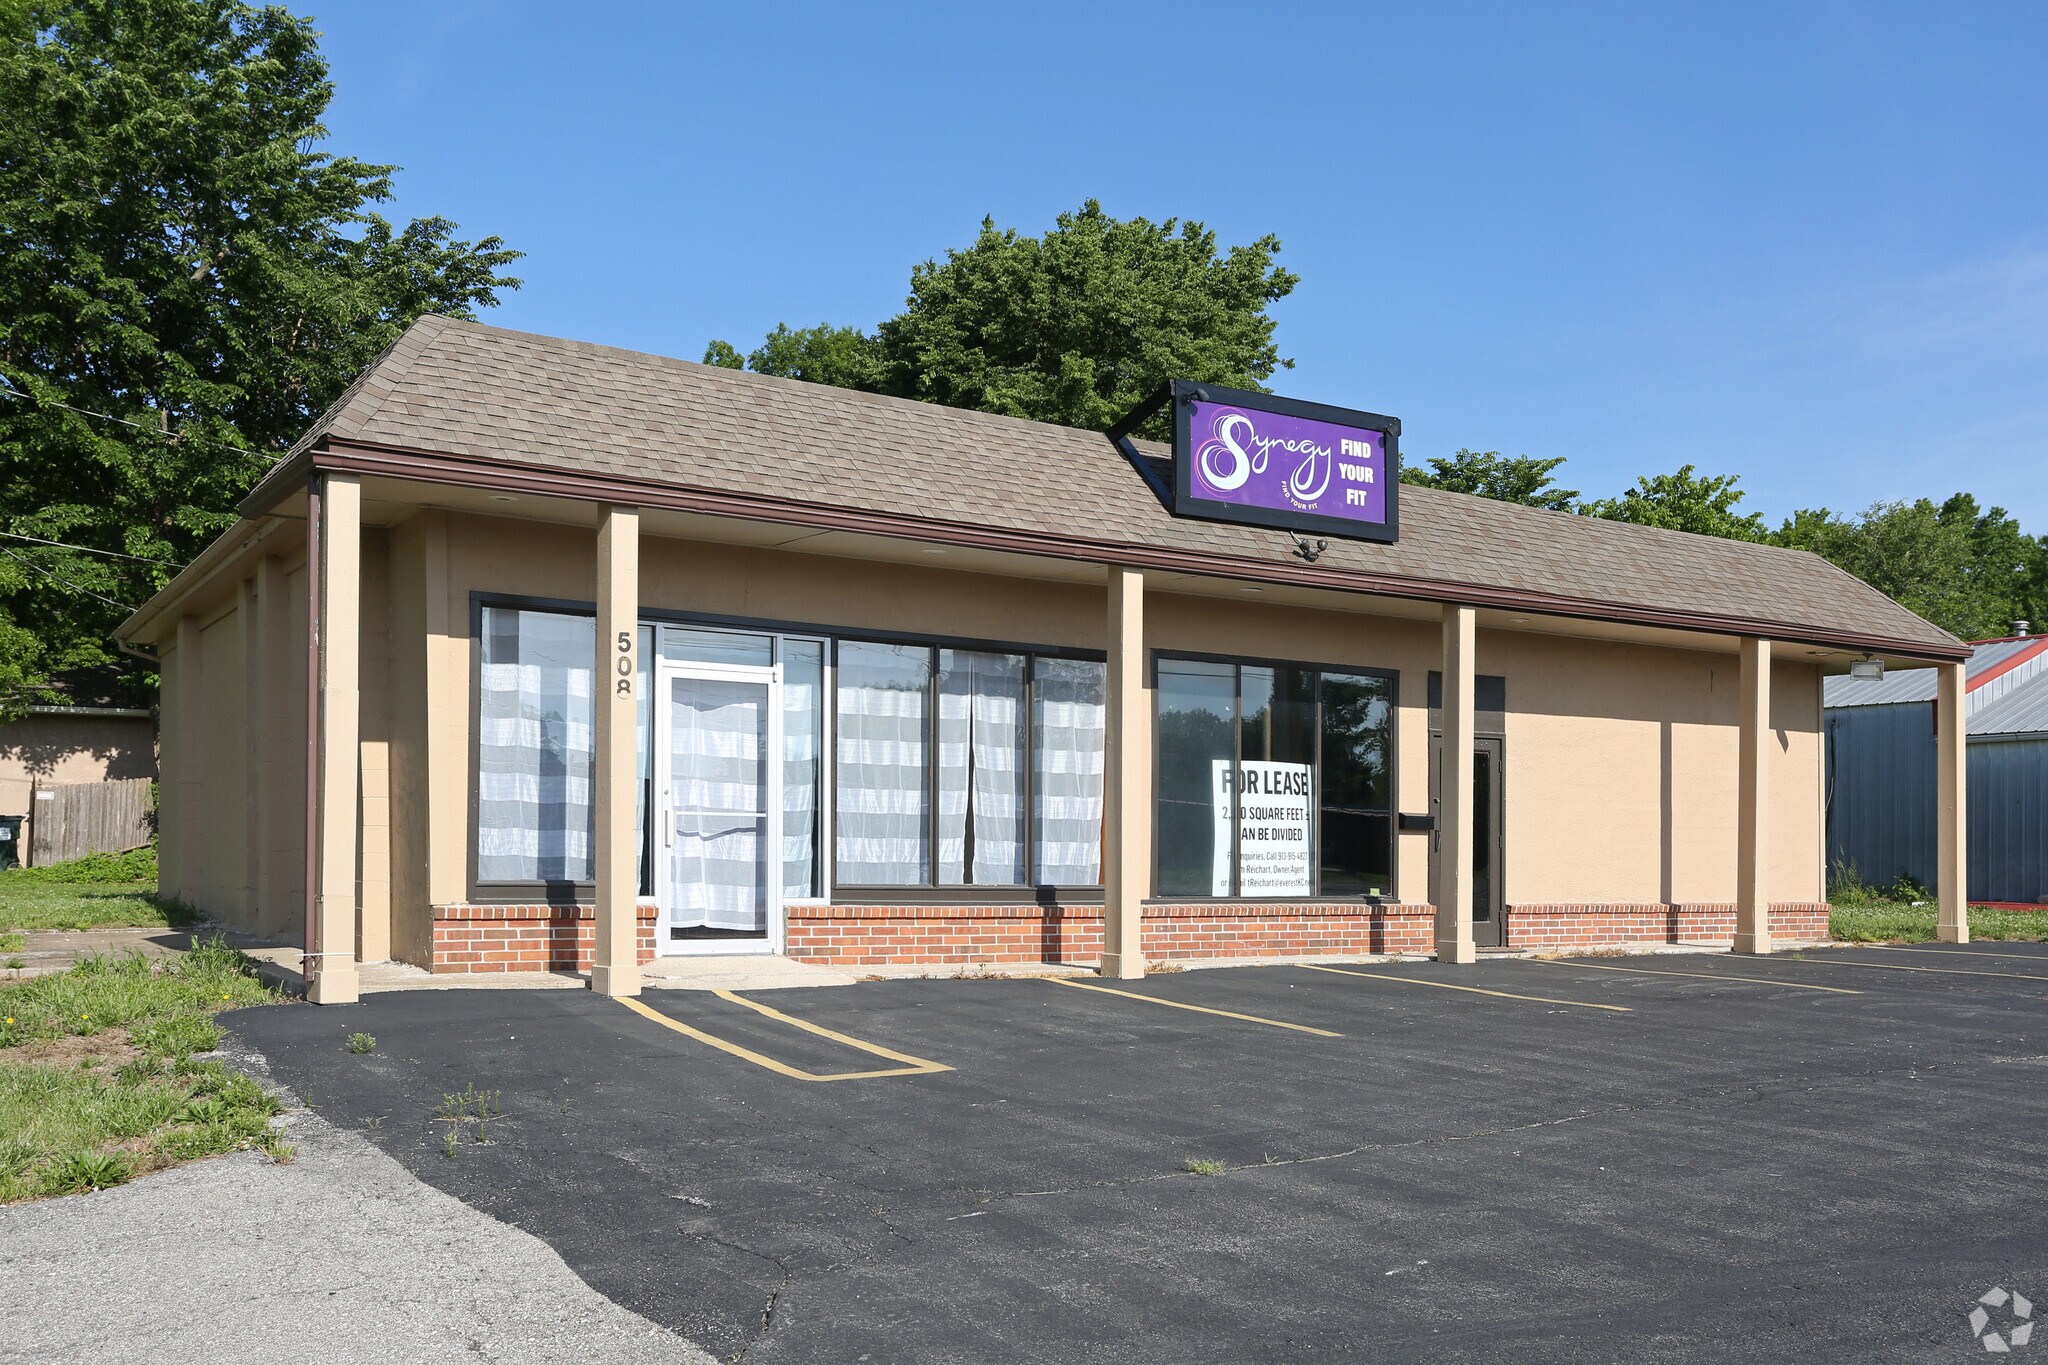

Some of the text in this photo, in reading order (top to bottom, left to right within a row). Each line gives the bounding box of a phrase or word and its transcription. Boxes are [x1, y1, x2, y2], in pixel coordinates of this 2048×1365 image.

[1340, 438, 1372, 459] FIND
[1338, 462, 1374, 484] YOUR
[1281, 480, 1318, 510] FIND YOUR FIT
[1346, 488, 1368, 507] FIT
[617, 631, 632, 700] 508
[1263, 770, 1308, 796] LEASE
[1249, 806, 1285, 821] SQUARE
[1286, 807, 1304, 821] FEET
[1241, 827, 1303, 841] AN BE DIVIDED
[1266, 851, 1278, 861] Call
